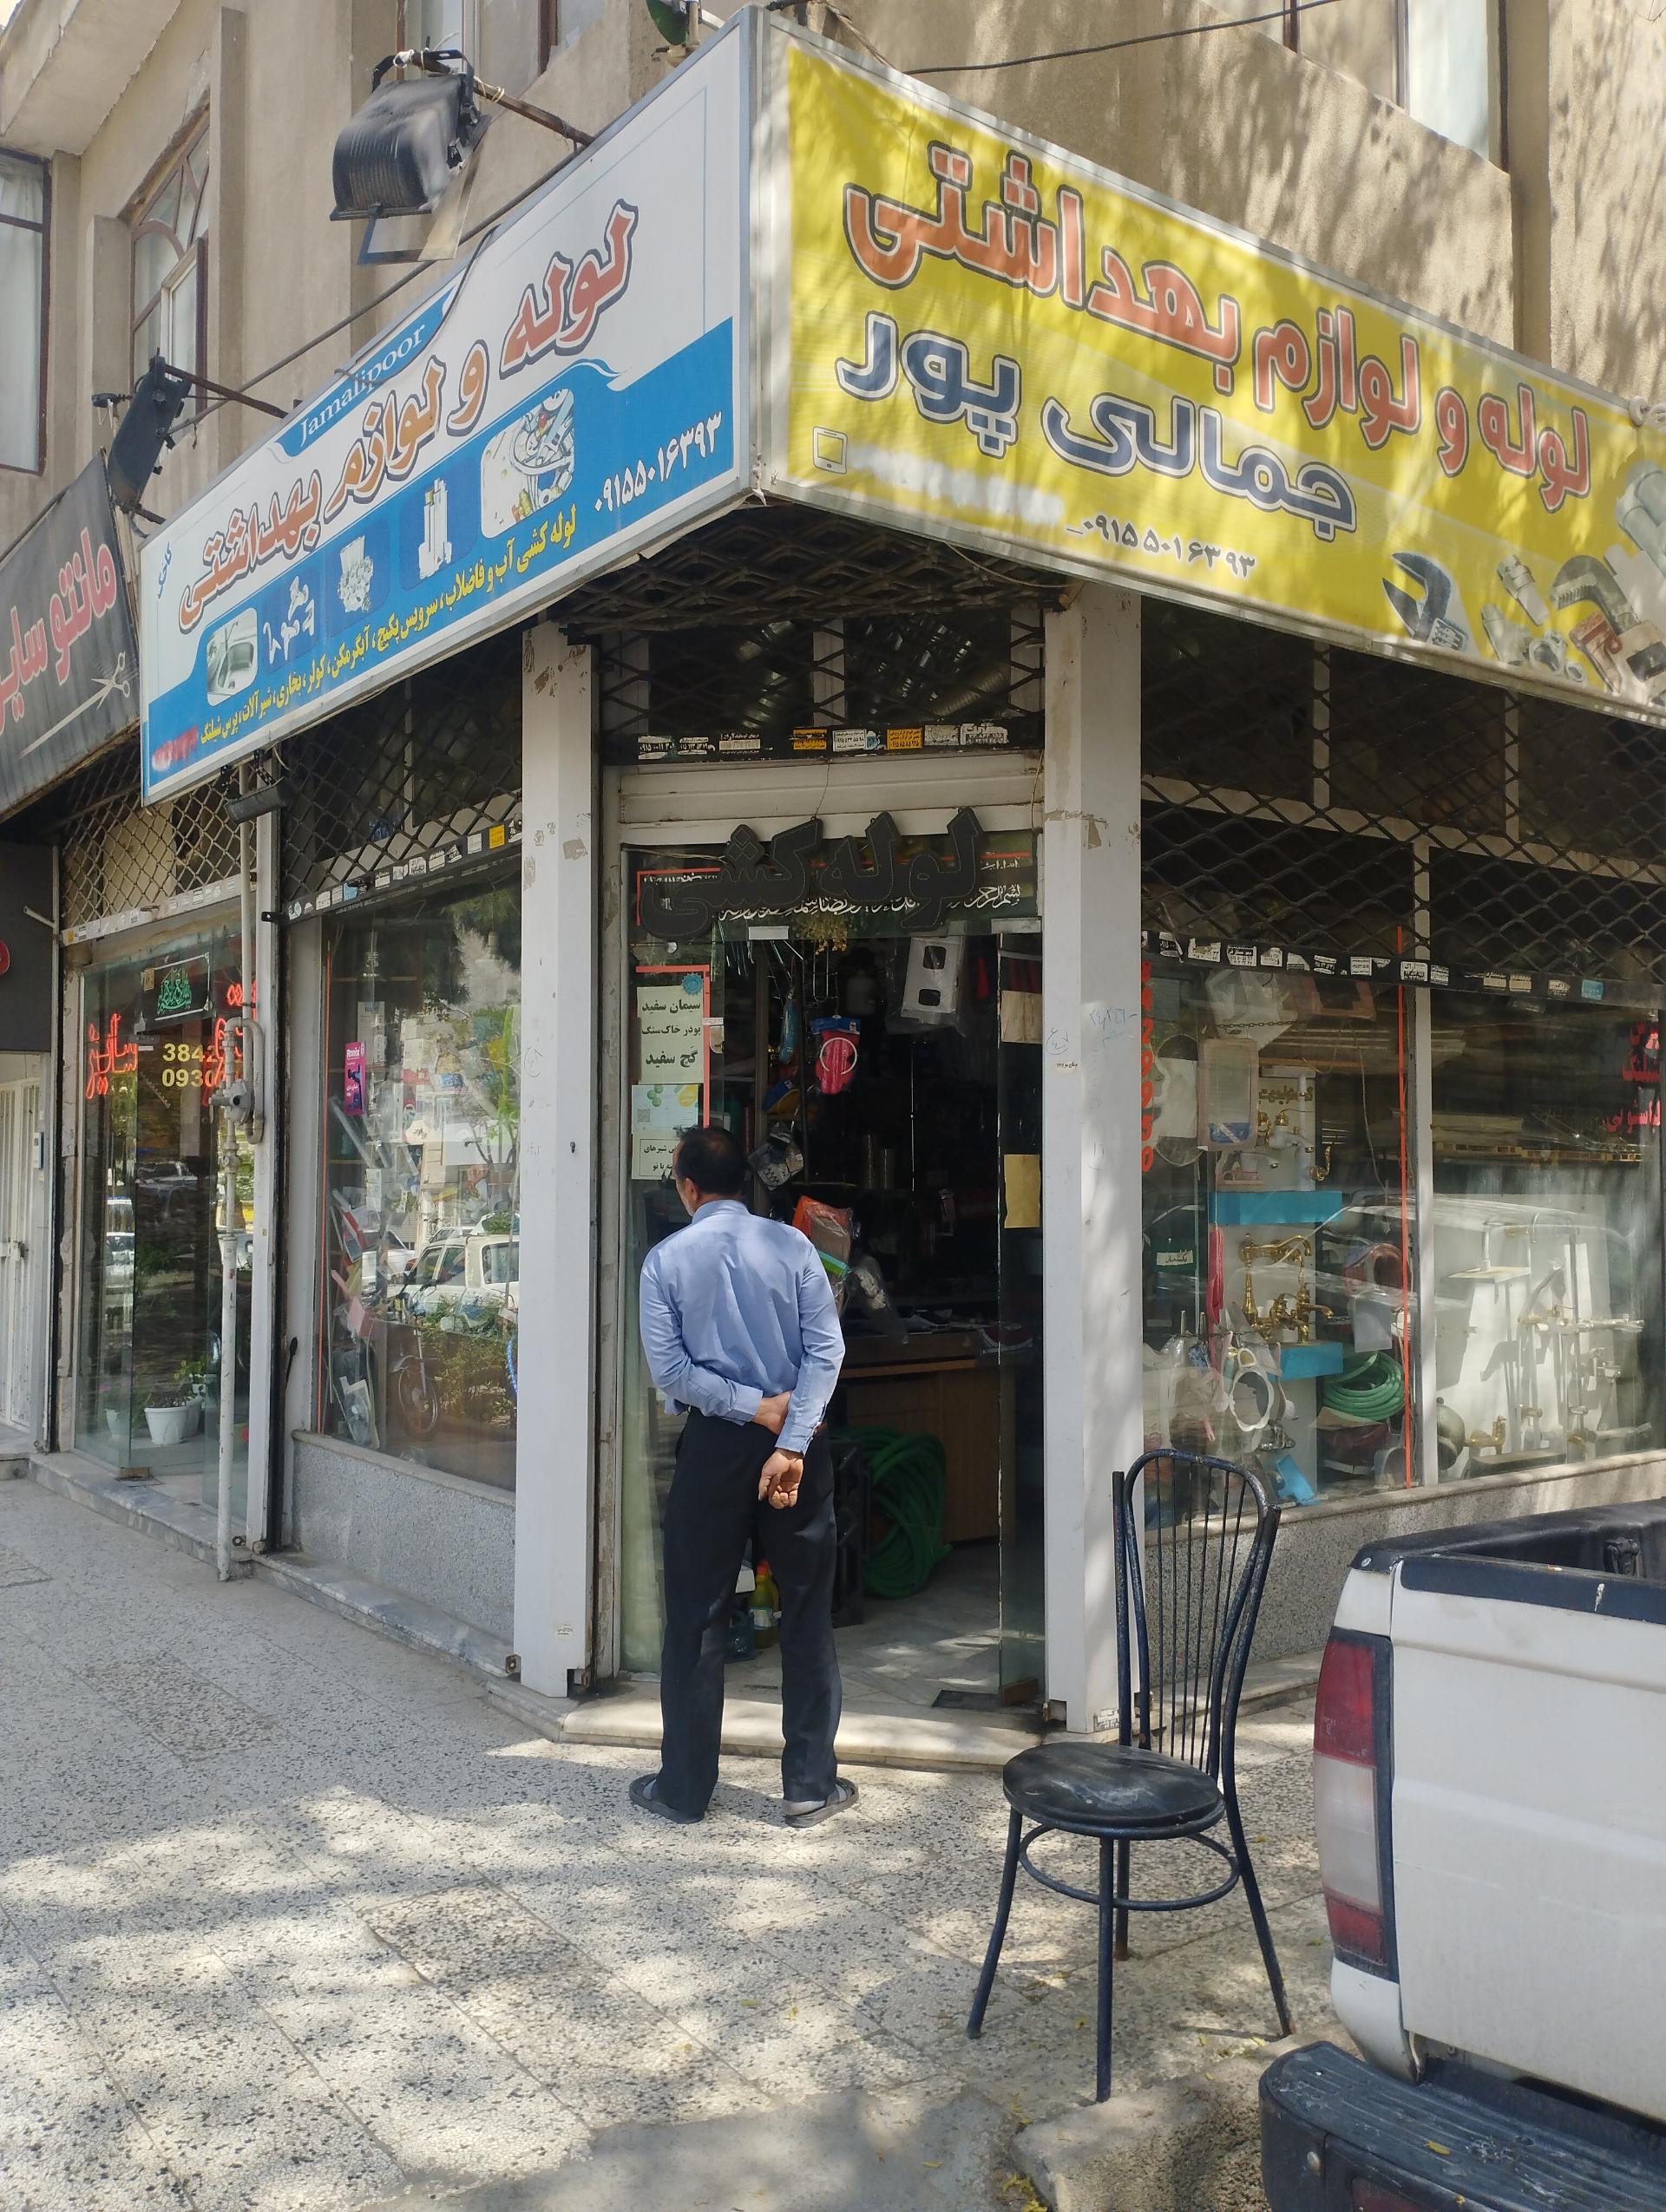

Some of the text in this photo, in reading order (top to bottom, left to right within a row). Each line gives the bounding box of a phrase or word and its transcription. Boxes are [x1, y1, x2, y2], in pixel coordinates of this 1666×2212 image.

[843, 140, 1591, 514] لوله و لوازم بهداشتی
[180, 199, 638, 633] لوله و لوازم بهداشتی
[300, 324, 425, 447] Jamalipoor
[836, 311, 1021, 461] پور
[594, 411, 722, 512] ۰۹۱۵۵۰۱۶۳۹۳
[1042, 393, 1357, 543] جمالی
[495, 538, 515, 584] آب
[516, 520, 548, 573] کشی
[550, 504, 576, 548] لوله
[49, 527, 117, 686] مانتو
[401, 597, 438, 639] سرویس
[487, 566, 494, 593] و
[201, 716, 221, 743] شیلنگ
[641, 807, 986, 940] لوله کشی
[642, 999, 701, 1014] سیمان سفید
[646, 1046, 699, 1068] گچ سفید
